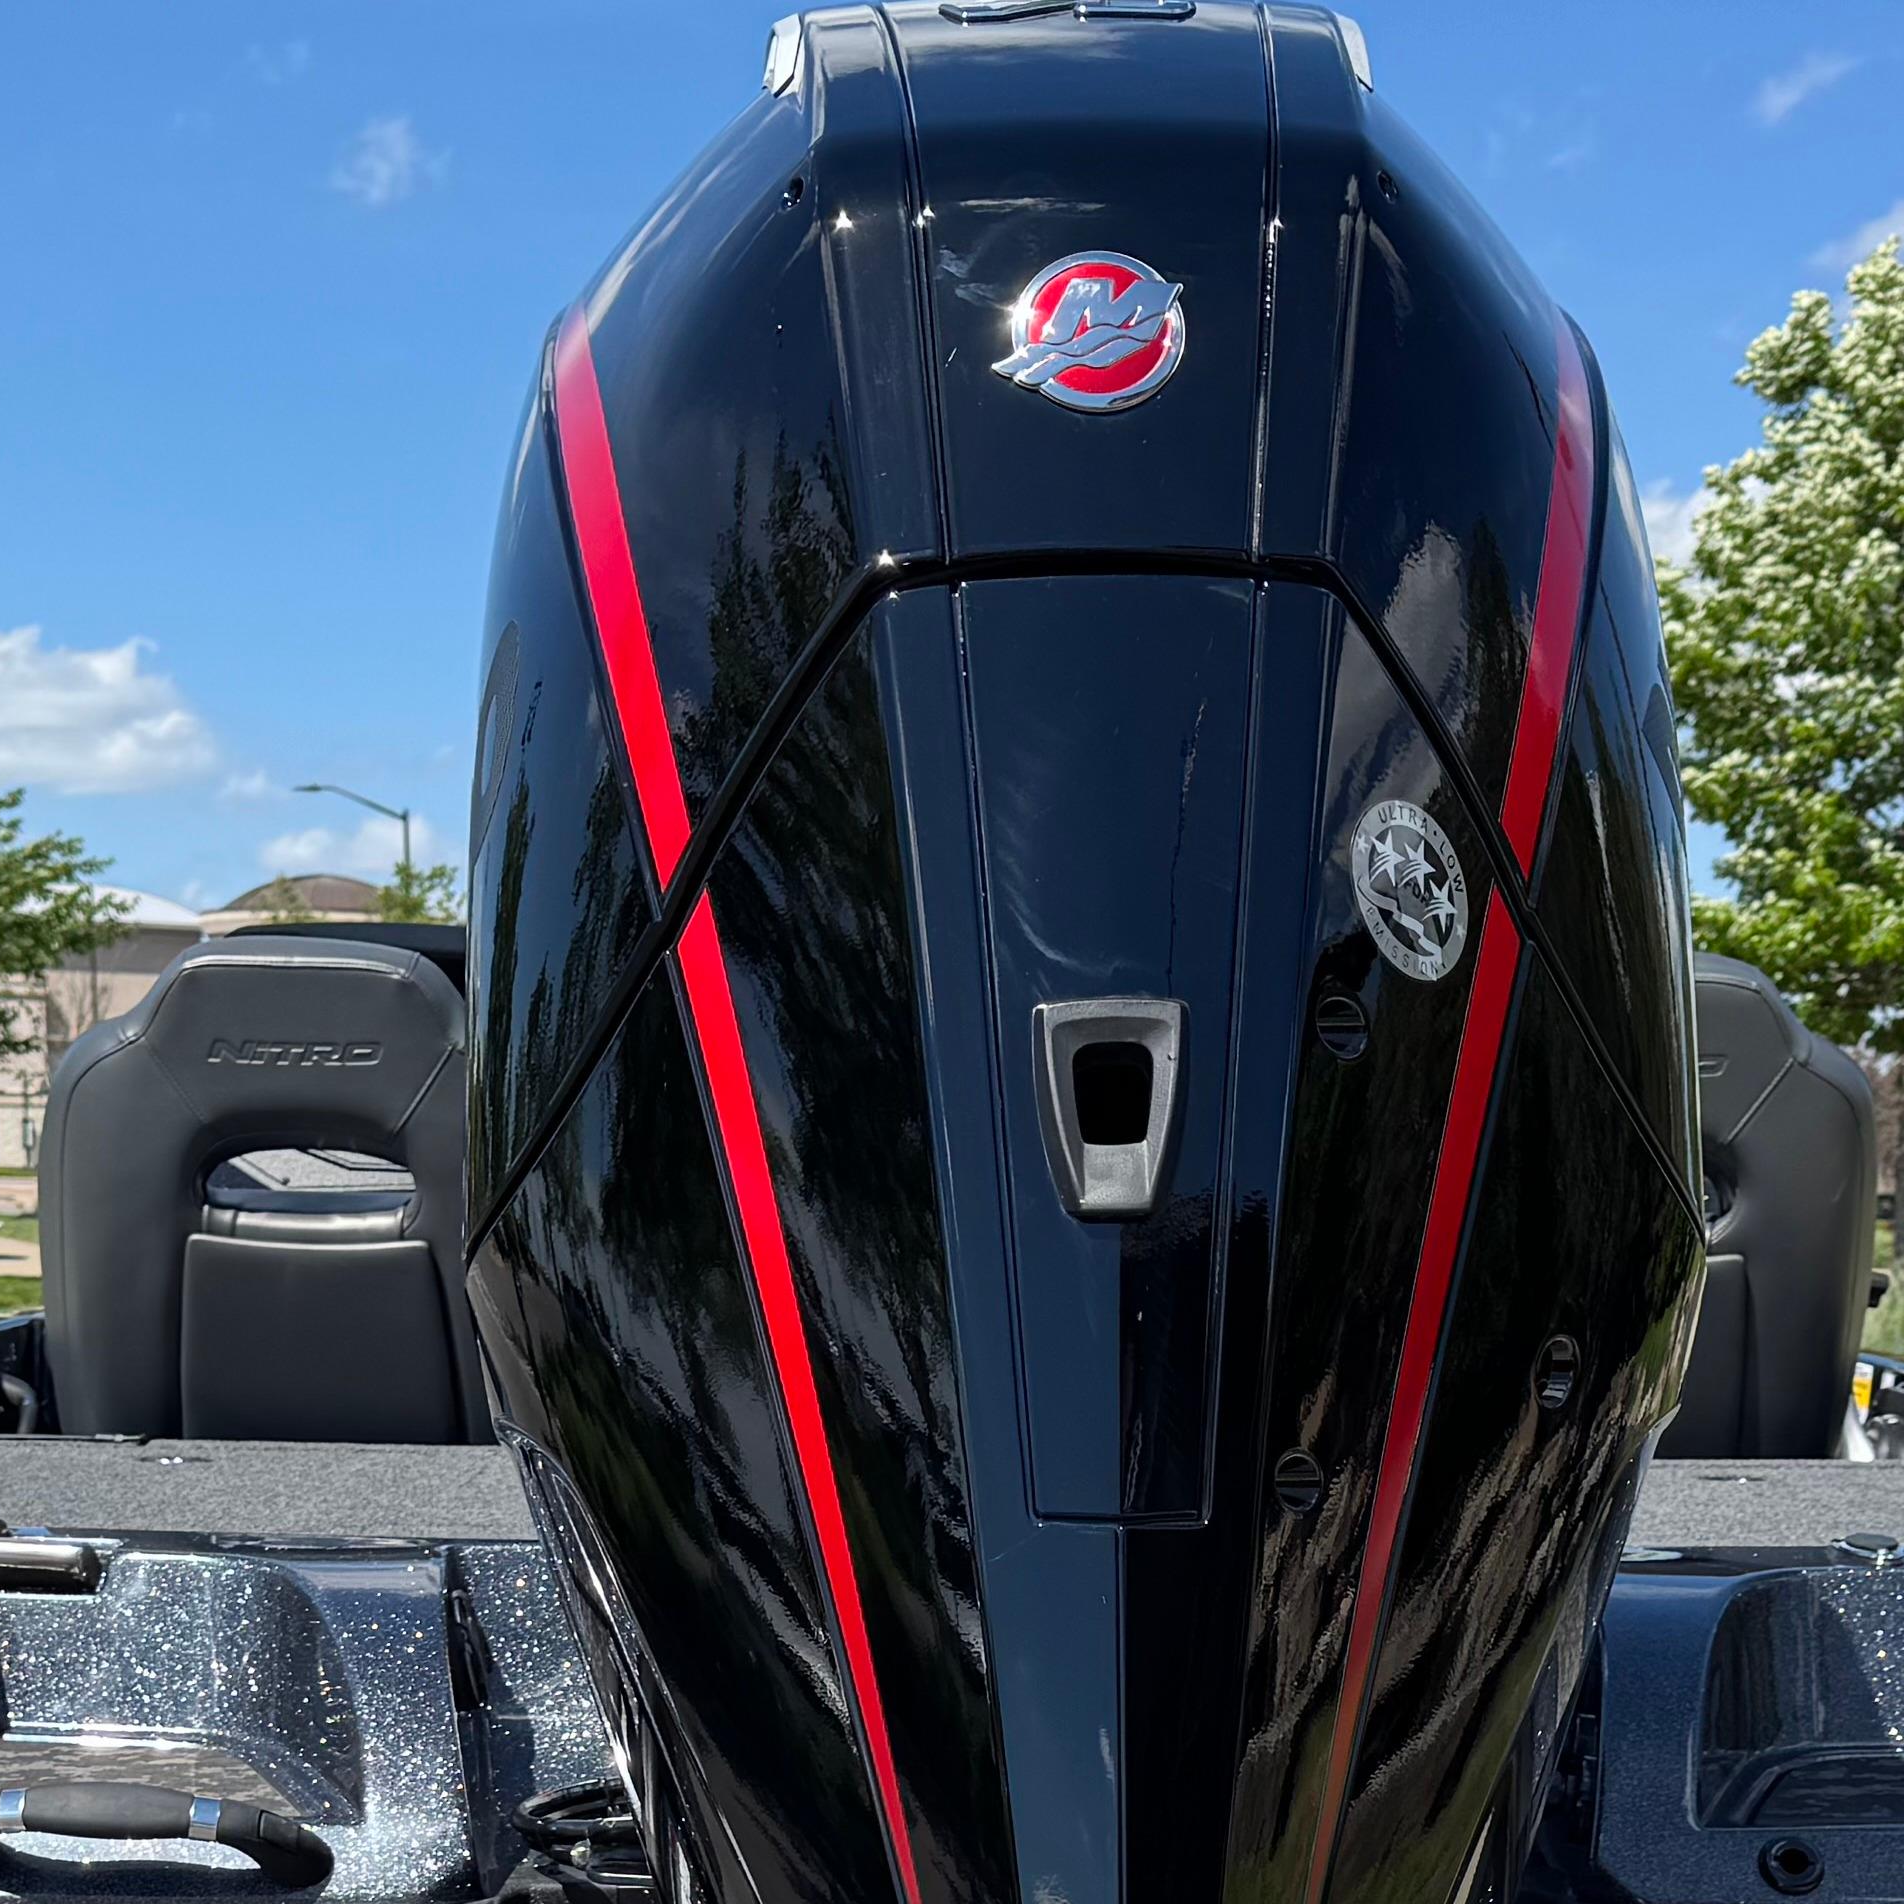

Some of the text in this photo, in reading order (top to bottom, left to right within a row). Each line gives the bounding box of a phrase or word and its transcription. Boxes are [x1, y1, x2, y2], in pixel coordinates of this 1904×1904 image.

[1378, 805, 1428, 833] ULTRA
[1439, 840, 1464, 892] LOW
[1366, 906, 1439, 976] EMISSION
[207, 1038, 384, 1066] NITRO
